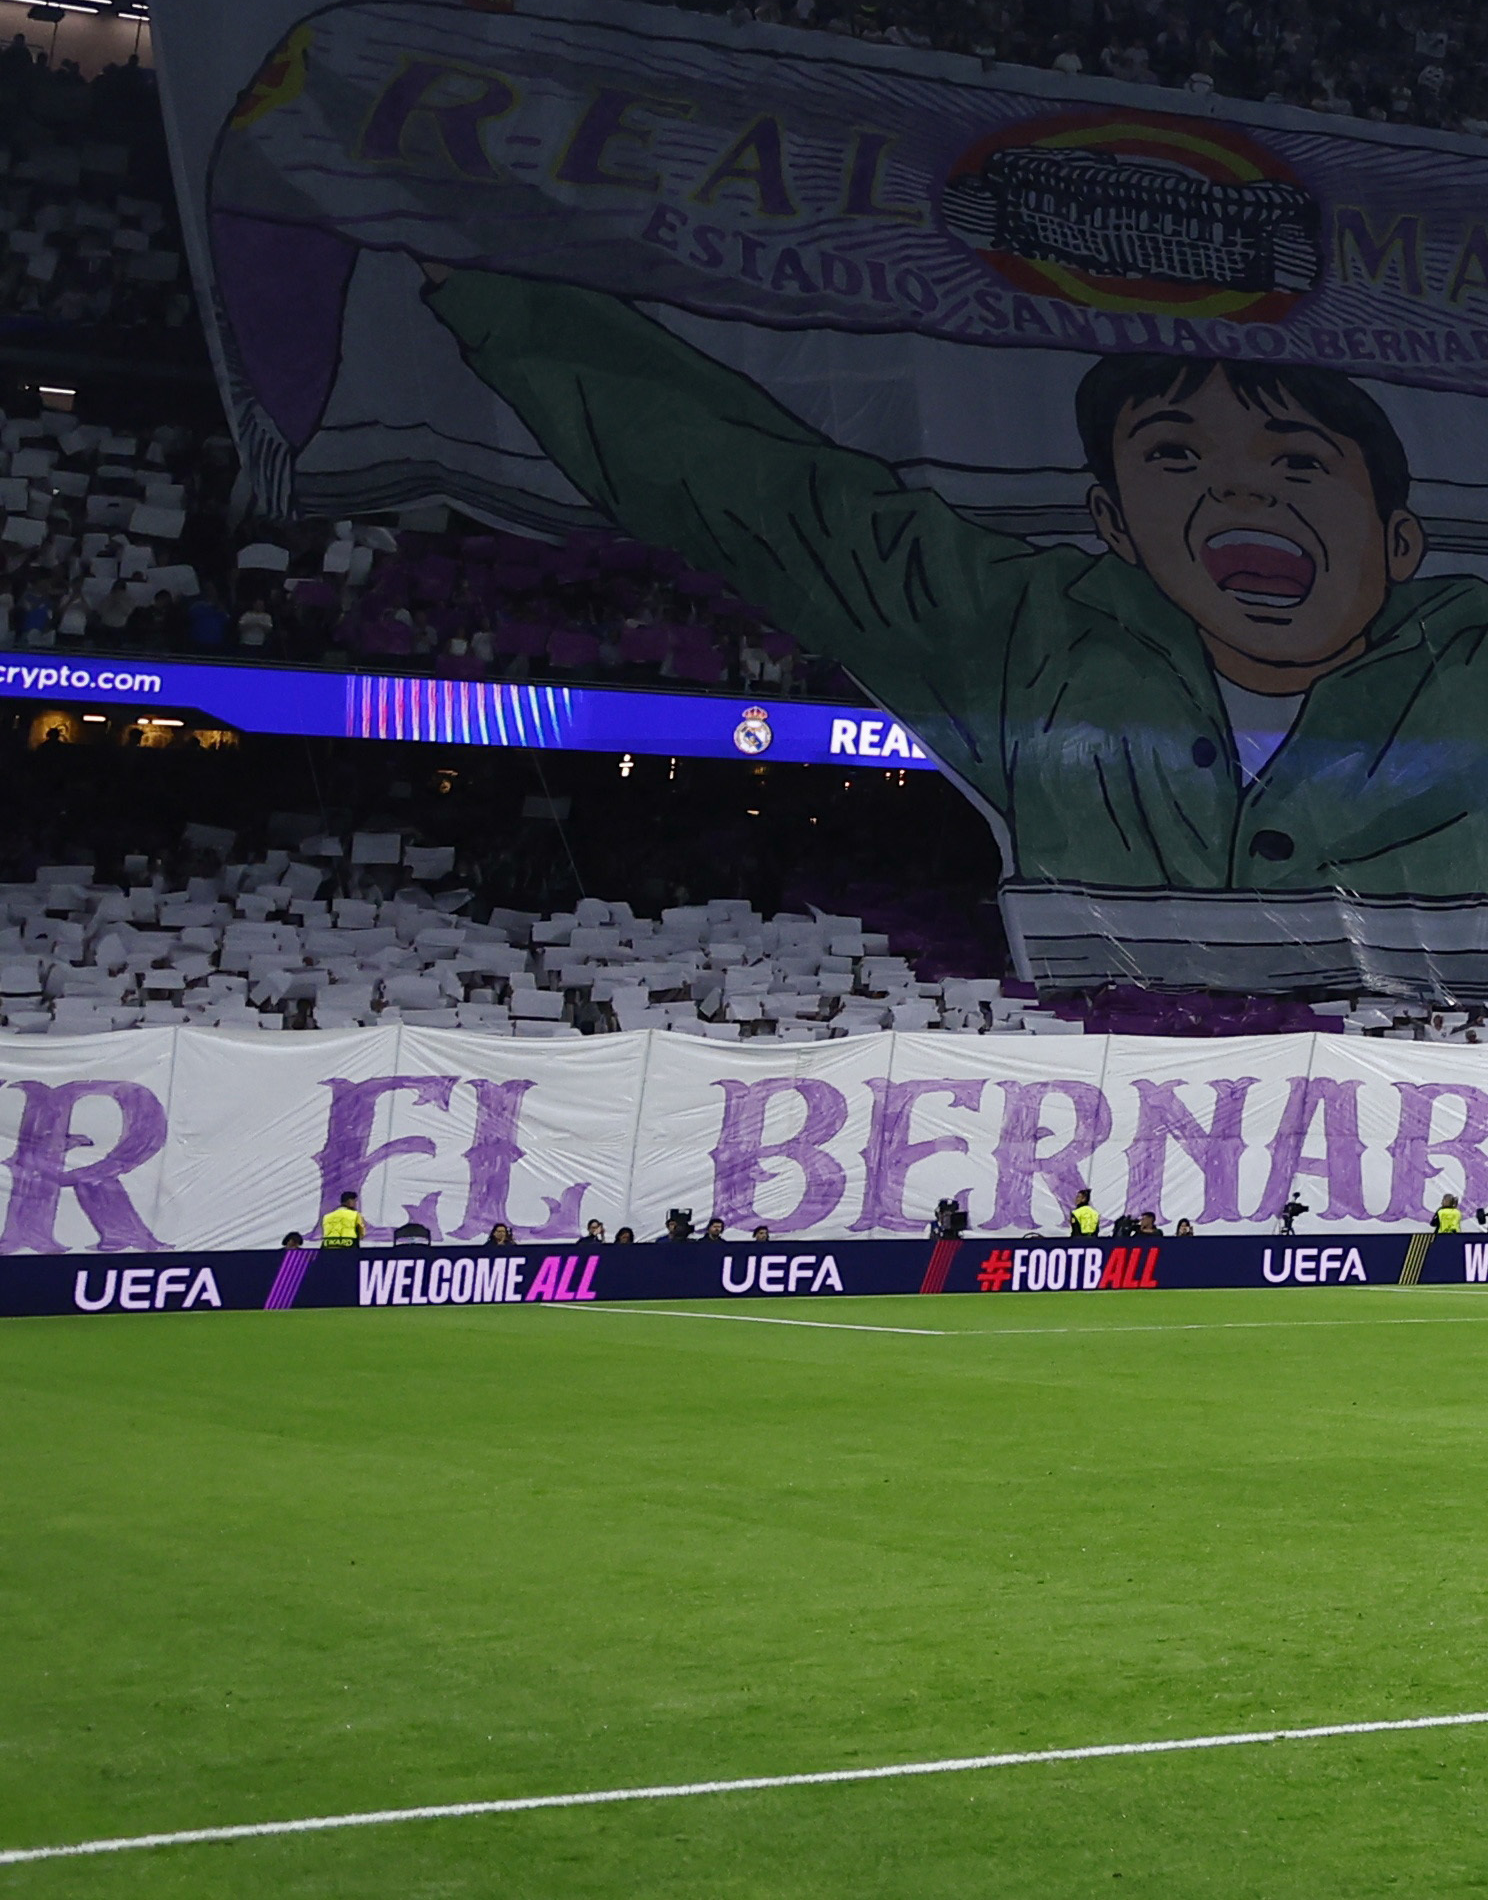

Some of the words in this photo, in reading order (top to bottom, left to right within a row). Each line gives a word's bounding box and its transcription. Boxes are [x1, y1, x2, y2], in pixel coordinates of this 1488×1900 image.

[355, 55, 925, 222] REAL
[641, 204, 941, 314] ESTADIO
[979, 289, 1287, 359] SANTIAGO
[0, 665, 161, 692] crypto.com
[0, 1078, 176, 1254] R
[303, 1074, 592, 1242] EL
[359, 1256, 526, 1306] WELCOME
[527, 1255, 600, 1302] ALL
[721, 1255, 844, 1293] UEFA
[976, 1247, 1160, 1292] #FOOTBALL
[1263, 1247, 1367, 1283] UEFA
[74, 1267, 222, 1311] UEFA
